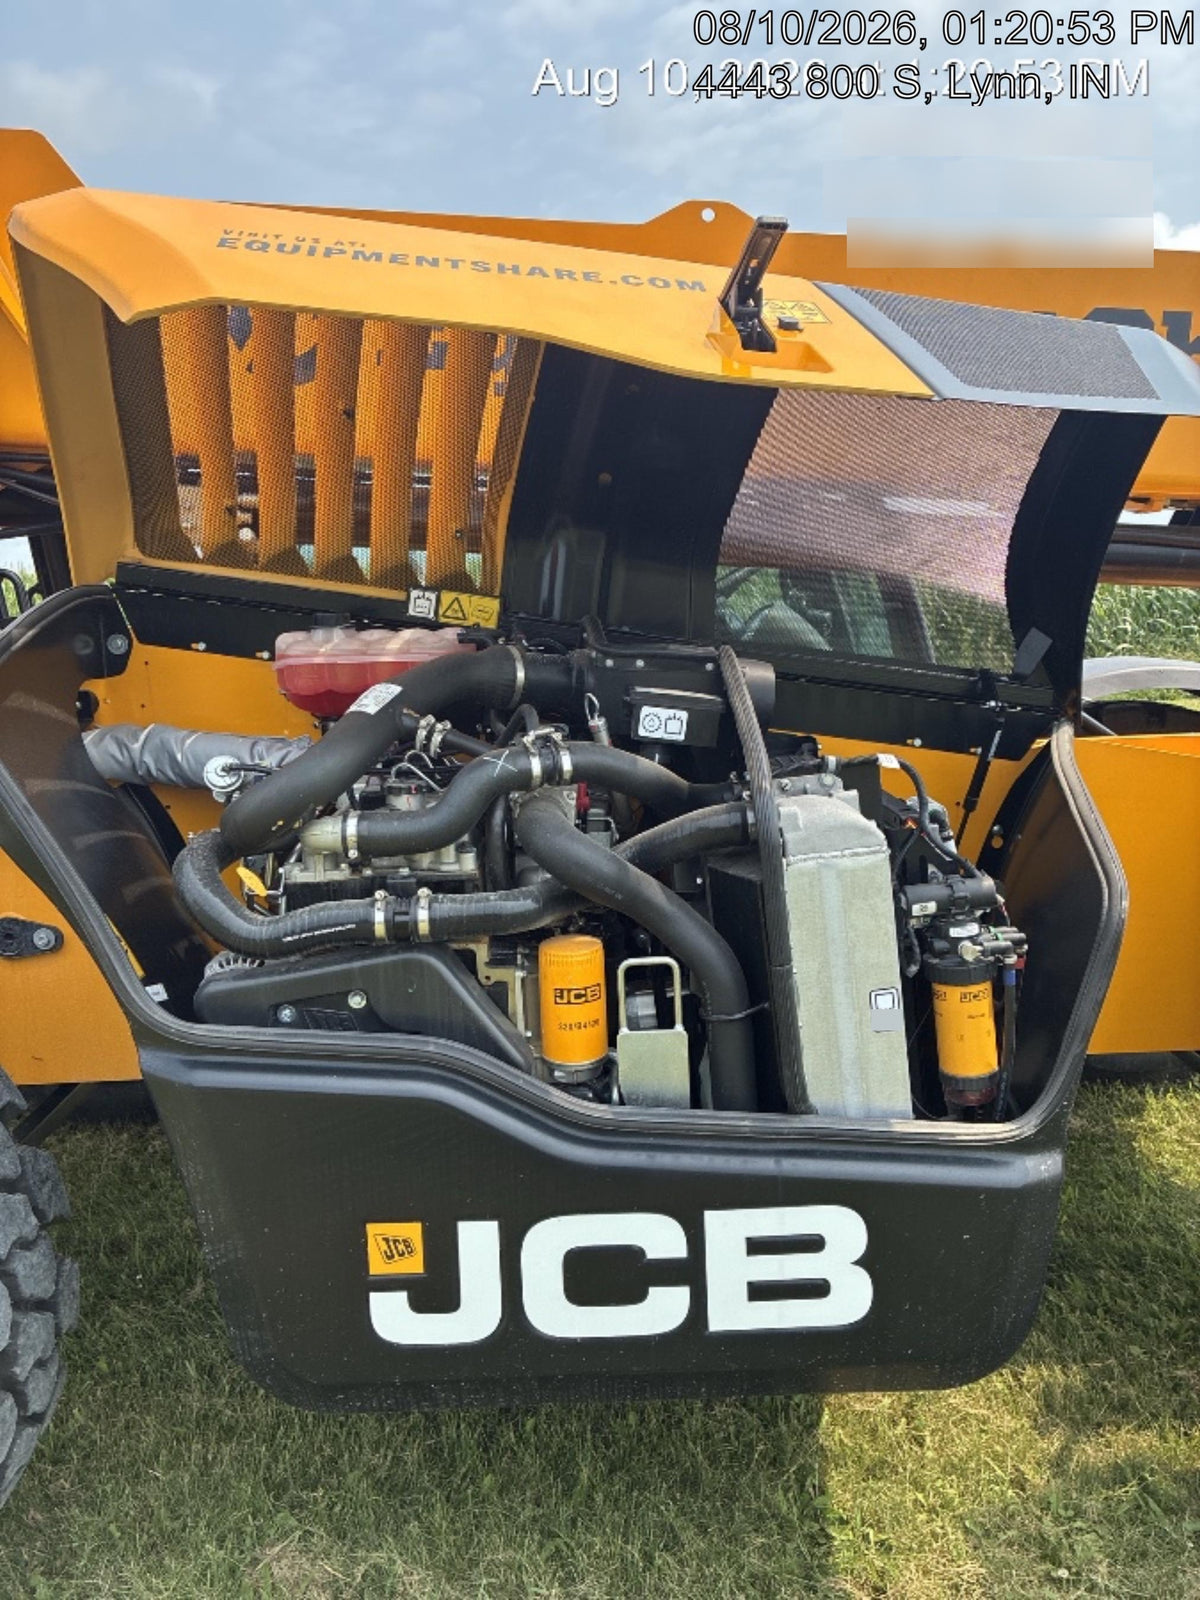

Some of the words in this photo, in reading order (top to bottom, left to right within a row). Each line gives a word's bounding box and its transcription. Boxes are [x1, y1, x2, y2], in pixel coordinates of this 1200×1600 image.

[223, 228, 284, 240] VISIT
[295, 235, 321, 245] US
[216, 236, 707, 293] EQUIPMENTSHARE.COM
[555, 984, 601, 1005] JCB
[381, 1236, 415, 1261] JCB
[368, 1204, 874, 1346] JCB
